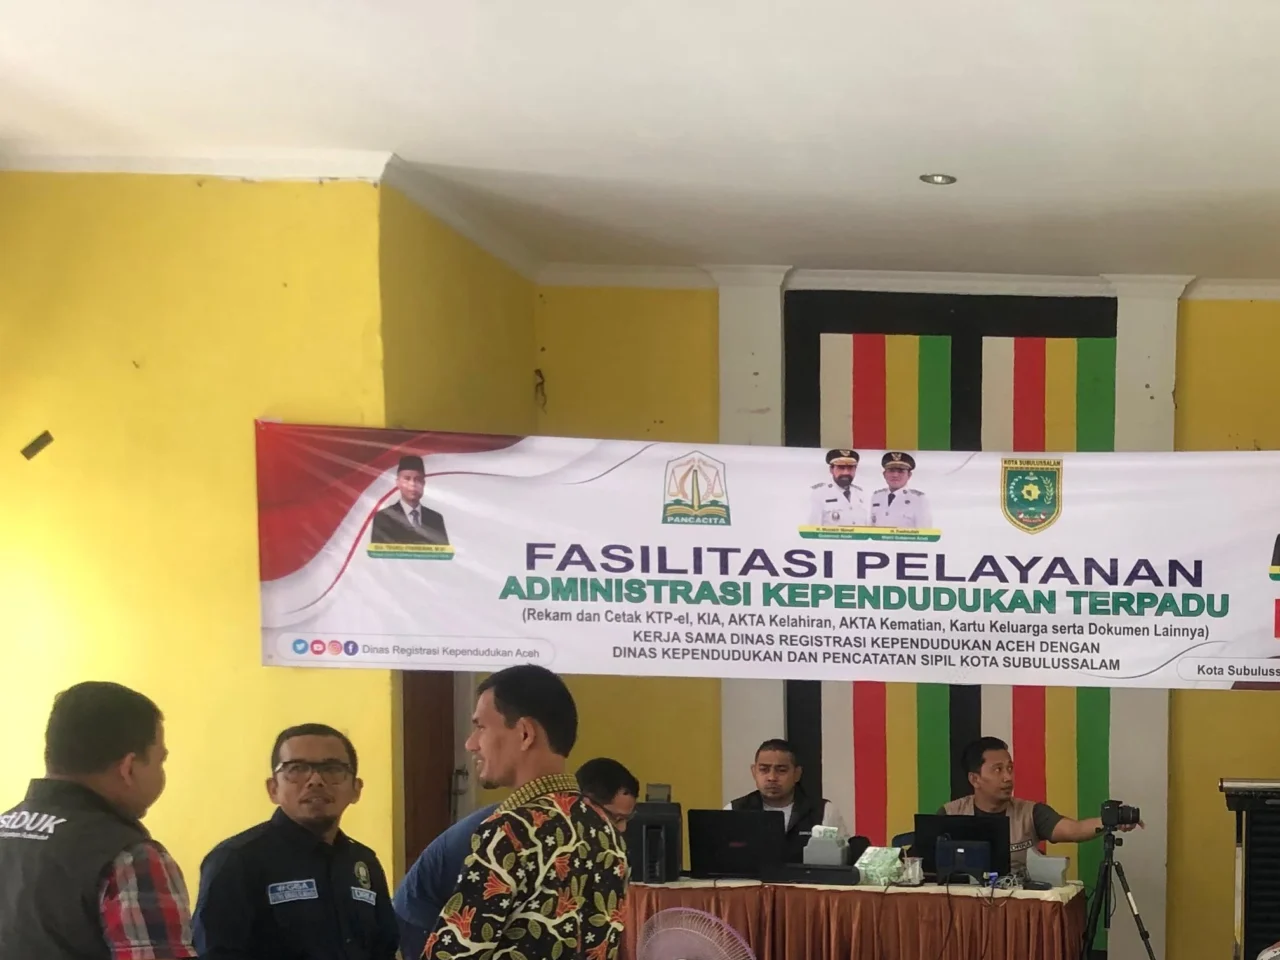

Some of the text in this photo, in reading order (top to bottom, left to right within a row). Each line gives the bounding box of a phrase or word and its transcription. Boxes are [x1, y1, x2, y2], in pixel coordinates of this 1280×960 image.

[667, 516, 726, 524] PANCACITA
[525, 542, 1203, 588] FASILITASI PELAYANAN
[499, 576, 1230, 618] ADMINISTRASI KEPENDUDUKAN TERPADU
[522, 607, 1210, 639] (Rekam dan Cetak KTP-el, KIA, AKTA Kelahiran, AKTA Kematian, Kartu Keluarga serta Dokumen Lainnya)
[362, 644, 540, 658] Dinas Registrasi Kependudukan Aceh
[633, 630, 1100, 654] KERJA SAMA DINAS REGISTRASI KEPENDUDUKAN ACEH DENGAN
[613, 646, 1121, 671] DINAS KEPENDUDUKAN DAN PENCATATAN SIPIL KOTA SUBULUSSALAM
[1197, 664, 1224, 676] Kota
